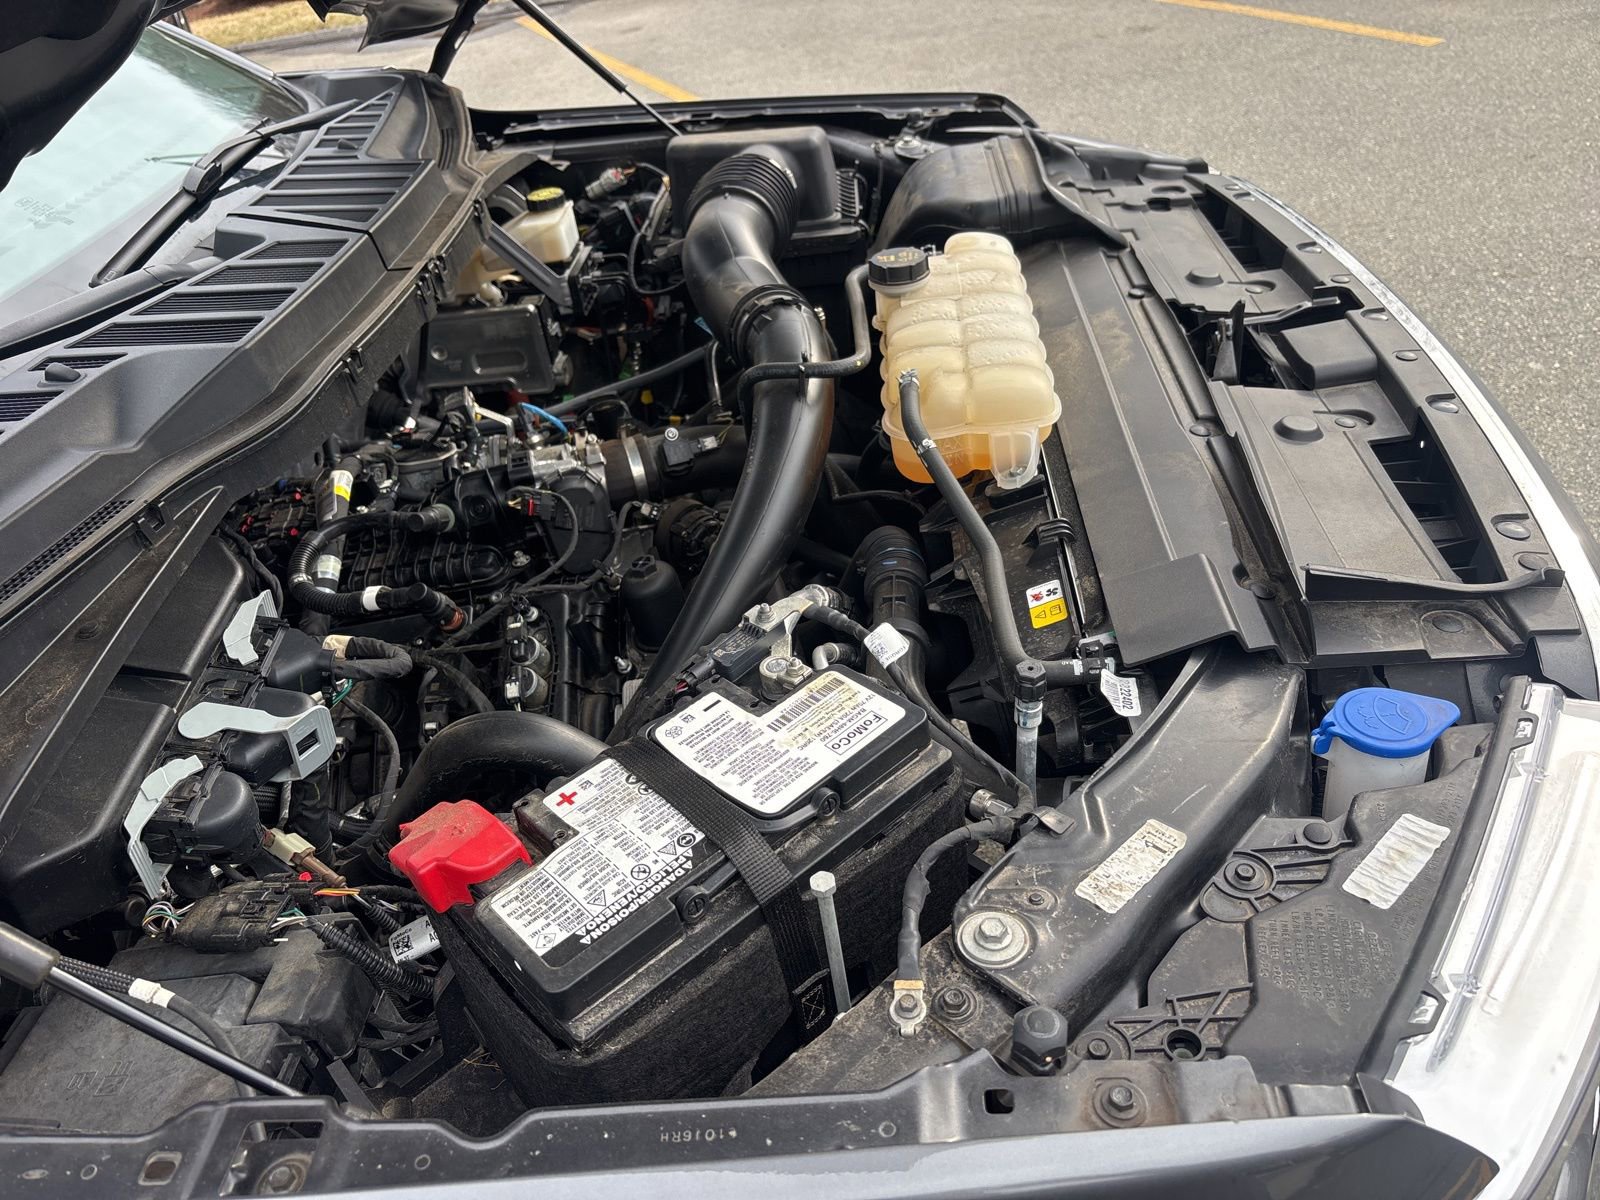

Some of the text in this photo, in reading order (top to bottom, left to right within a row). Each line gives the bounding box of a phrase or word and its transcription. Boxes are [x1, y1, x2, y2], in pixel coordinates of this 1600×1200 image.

[829, 711, 882, 753] FoMoCo
[584, 854, 687, 930] PELIGRO/VENENO
[588, 867, 688, 939] DANGER/POISON
